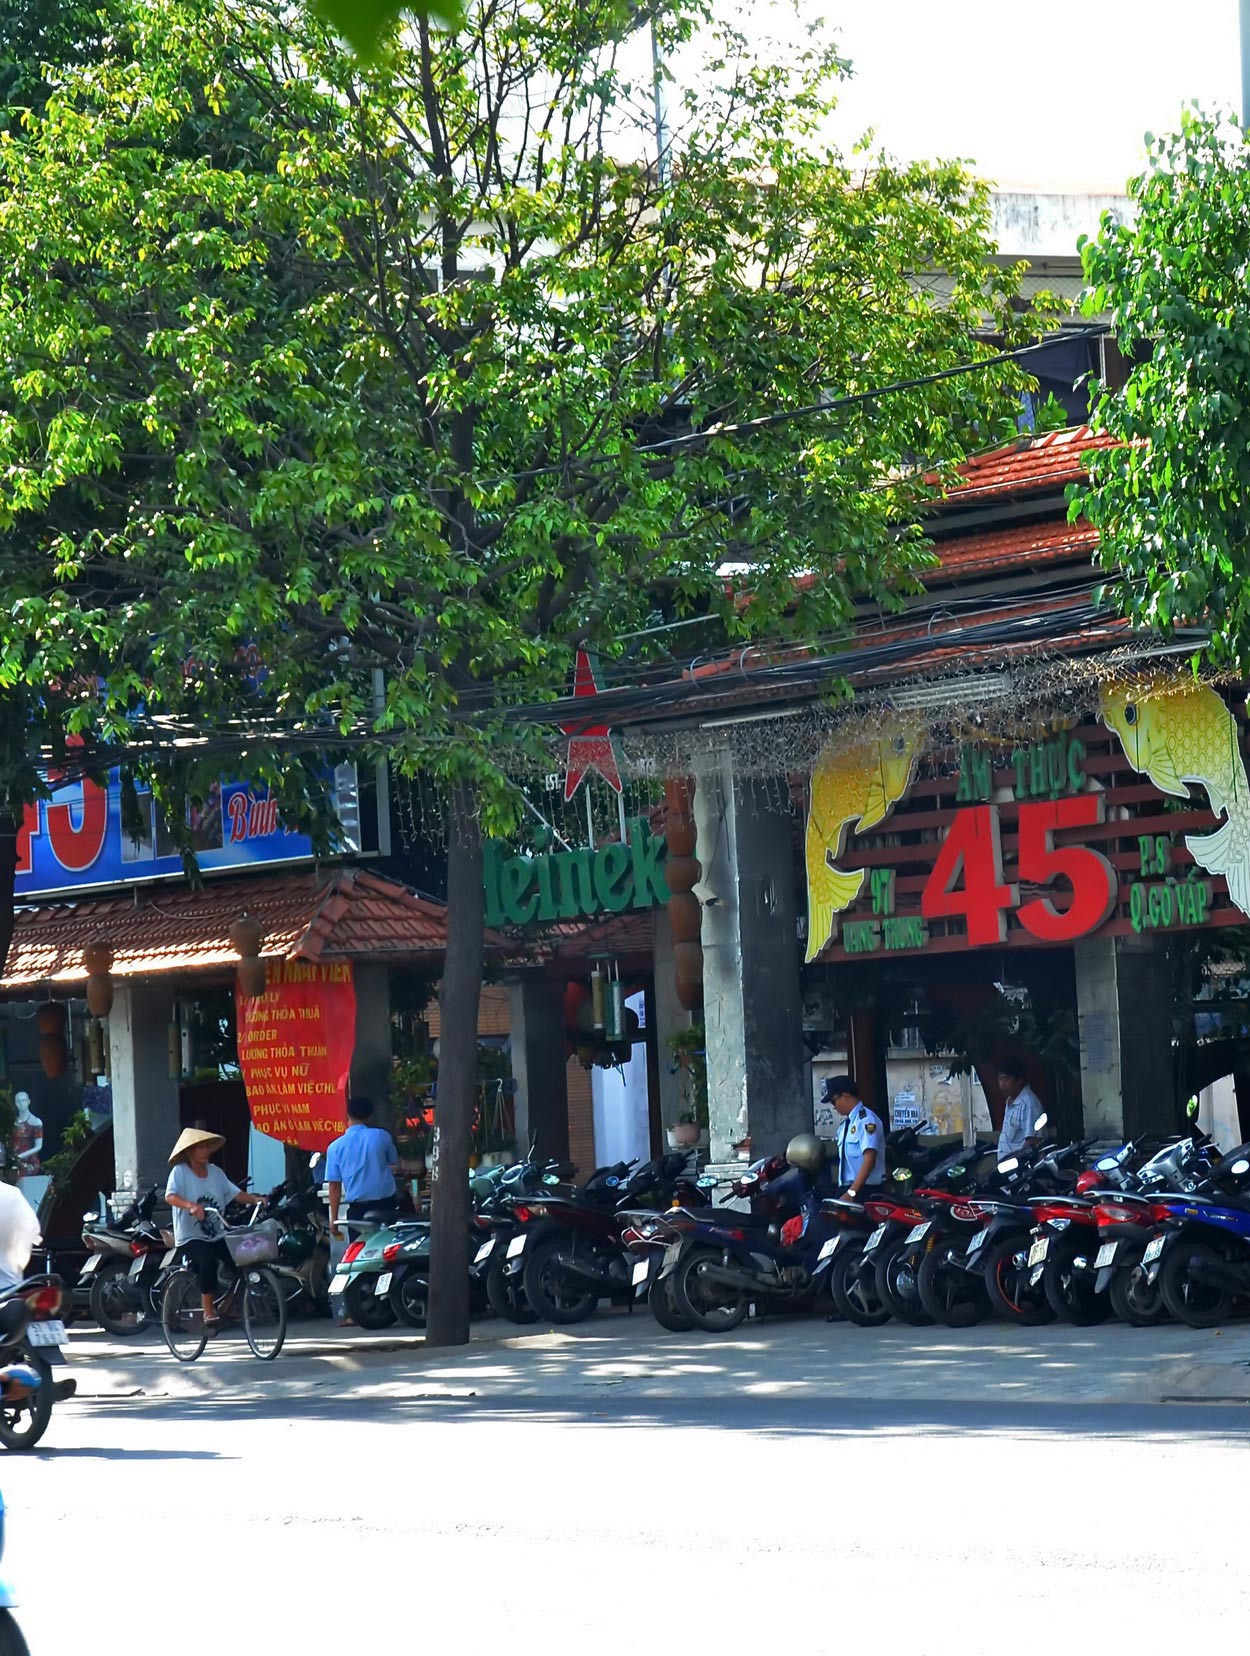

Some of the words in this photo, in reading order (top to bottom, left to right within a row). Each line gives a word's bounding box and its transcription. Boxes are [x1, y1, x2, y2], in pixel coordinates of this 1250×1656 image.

[921, 795, 1118, 945] 45
[247, 1029, 278, 1042] ORDER
[270, 1043, 295, 1058] THỎA
